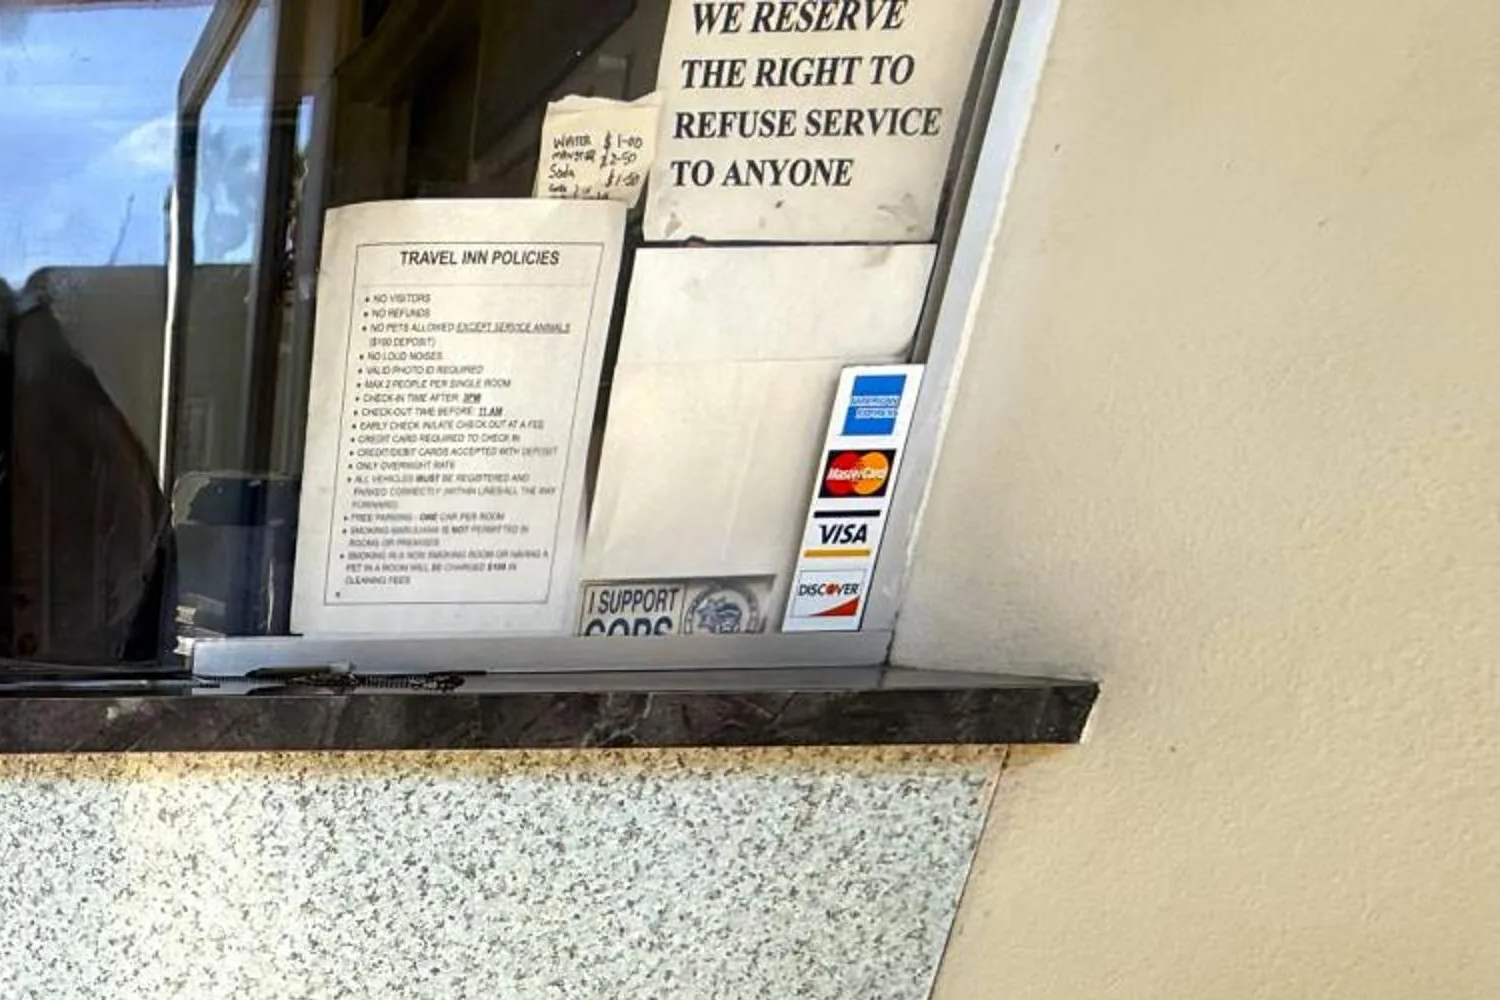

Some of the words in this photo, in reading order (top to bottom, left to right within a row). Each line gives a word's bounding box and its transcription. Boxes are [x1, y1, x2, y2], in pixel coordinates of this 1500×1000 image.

[693, 2, 741, 34] WE
[750, 0, 903, 33] RESERVE
[682, 59, 747, 88] THE
[752, 57, 862, 87] RIGHT
[870, 55, 915, 85] TO
[673, 110, 797, 139] REFUSE
[804, 108, 942, 137] SERVICE
[671, 160, 715, 187] TO
[723, 158, 854, 187] ANYONE
[400, 250, 459, 266] TRAVEL
[462, 250, 489, 266] INN
[492, 250, 560, 265] POLICIES
[373, 294, 386, 303] NO
[390, 293, 431, 302] VISITORS
[372, 309, 386, 318] NO
[388, 308, 431, 318] REFUNDS
[370, 323, 385, 333] NO
[386, 323, 410, 333] PETS
[412, 323, 455, 333] ALLOWED
[368, 352, 381, 361] NO
[383, 352, 407, 361] LOUD
[366, 366, 389, 375] VALID
[391, 366, 423, 375] PHOTO
[819, 523, 868, 544] VISA
[798, 582, 860, 597] DISCOVER
[588, 591, 595, 613] I
[598, 588, 679, 614] SUPPORT
